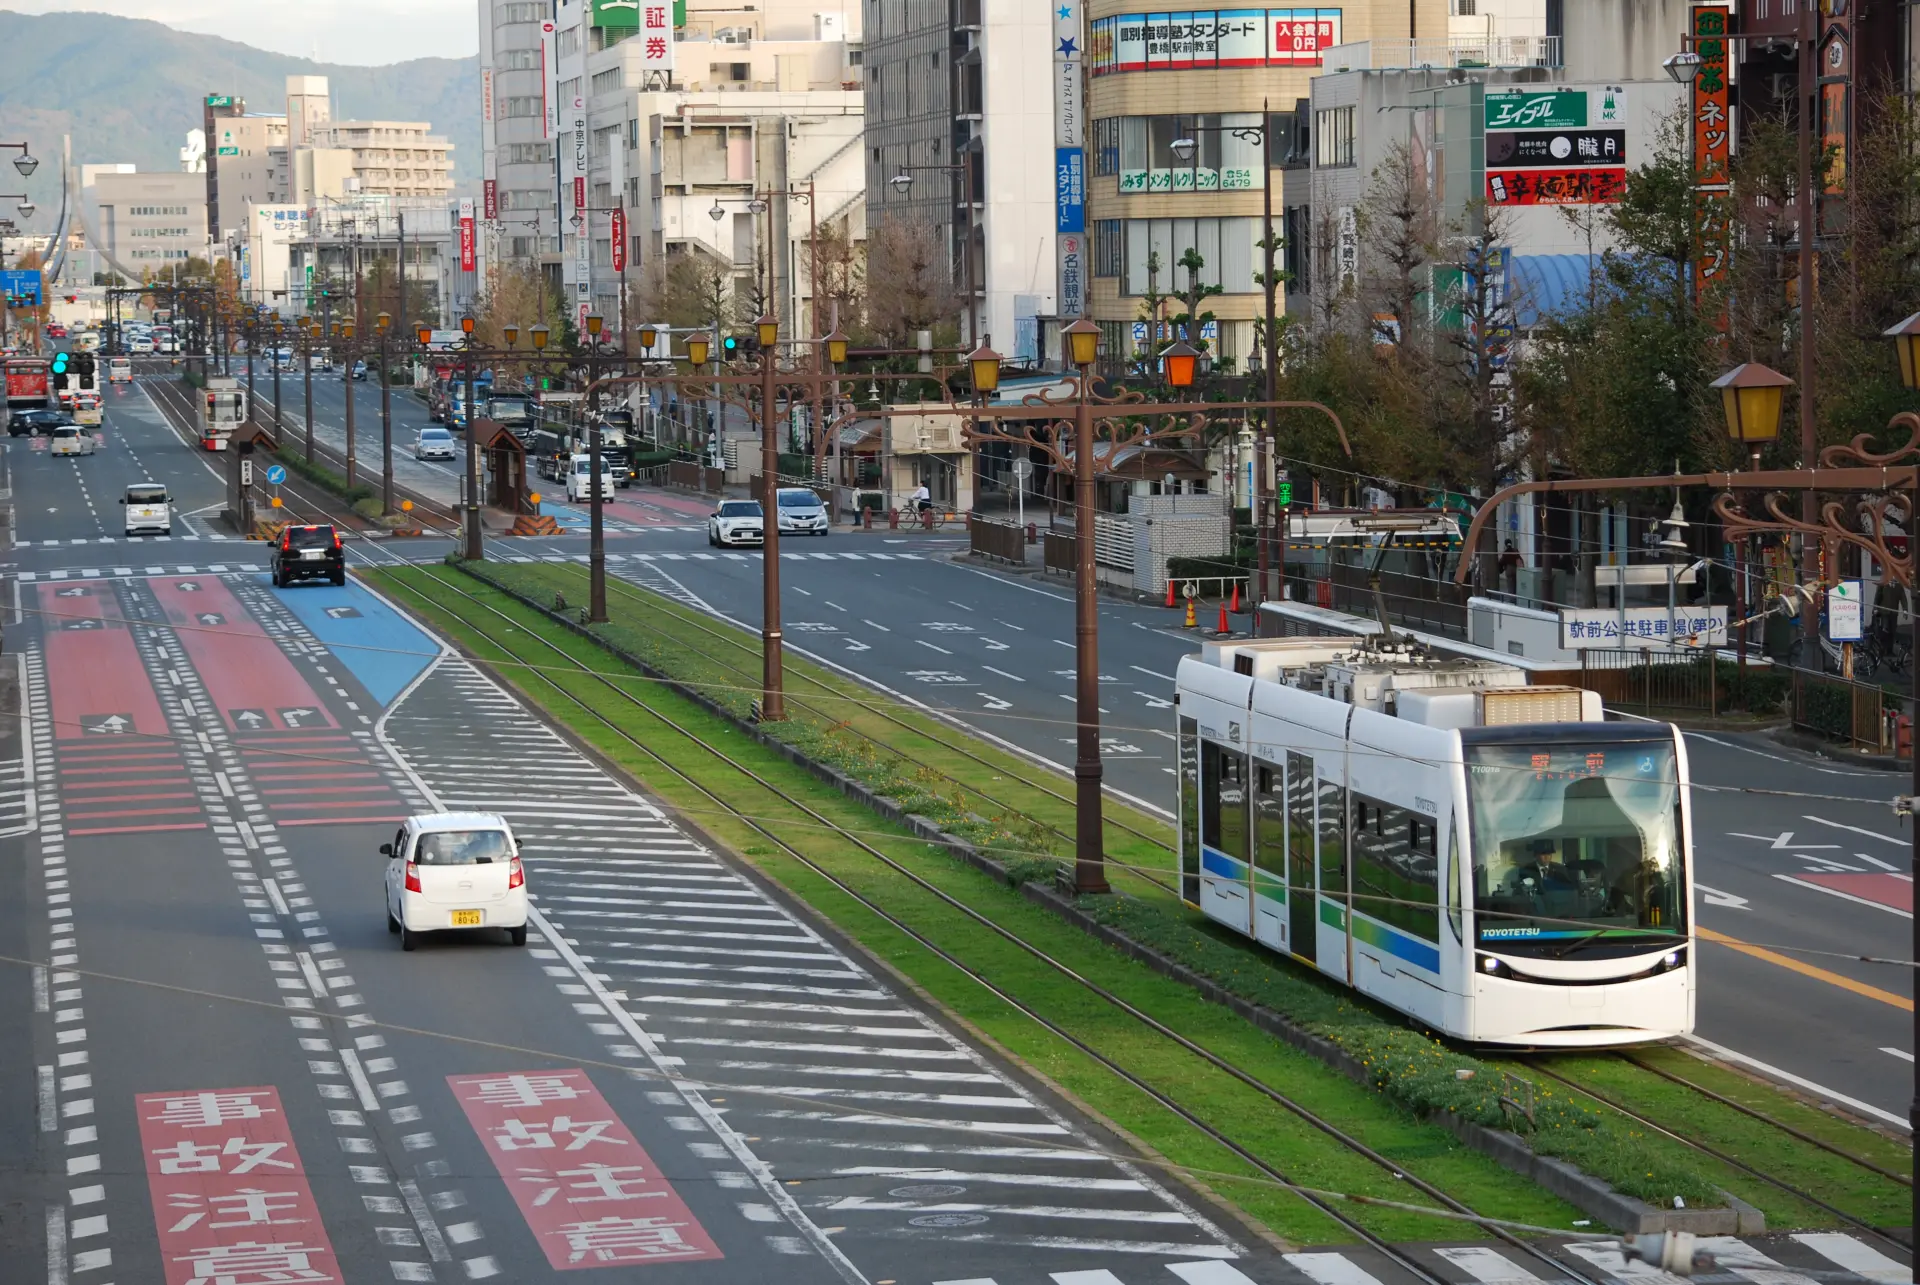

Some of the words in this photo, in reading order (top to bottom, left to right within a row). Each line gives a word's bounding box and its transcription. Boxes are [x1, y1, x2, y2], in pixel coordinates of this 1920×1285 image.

[645, 7, 666, 59] 証券
[1119, 21, 1256, 41] 個別指導塾スタンダード
[1279, 23, 1330, 37] 入会費用
[1148, 40, 1217, 55] 豊橋駅前教室
[1293, 36, 1316, 51] 0円
[1489, 95, 1556, 126] エイブル
[1603, 110, 1616, 120] MK
[574, 119, 585, 171] 中京テレビ
[1070, 154, 1081, 205] 個別指導塾
[1222, 179, 1250, 188] 6479
[1059, 165, 1070, 226] スタンダード
[1063, 254, 1079, 314] 名鉄観光
[1482, 927, 1541, 937] TOYOTETSU
[456, 1074, 706, 1263] 事故注意
